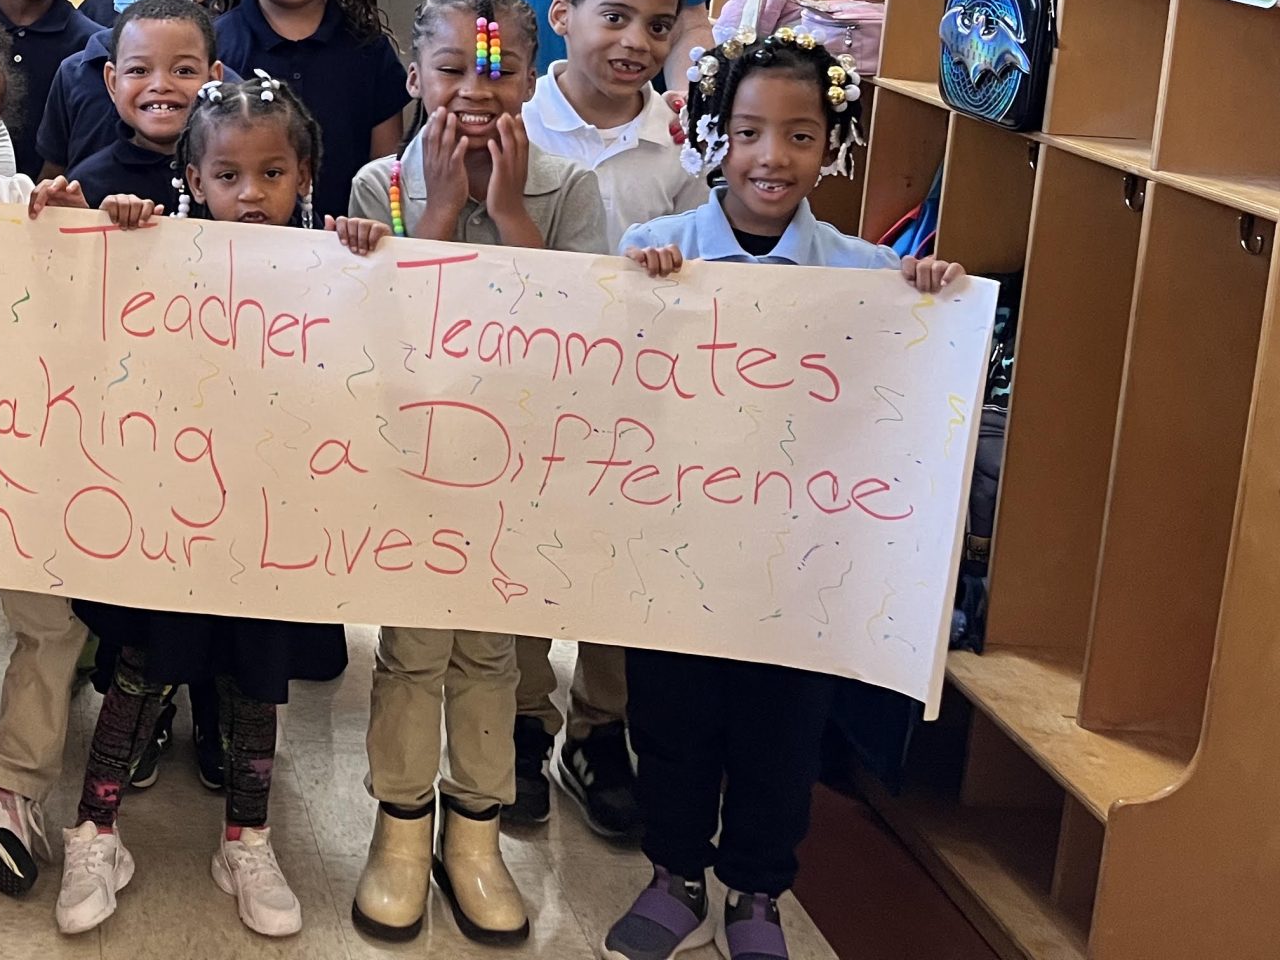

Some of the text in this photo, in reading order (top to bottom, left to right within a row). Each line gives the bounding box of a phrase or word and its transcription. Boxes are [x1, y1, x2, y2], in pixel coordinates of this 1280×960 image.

[59, 222, 331, 368] Teacher
[396, 252, 842, 403] Teammates
[308, 438, 369, 477] a
[398, 400, 915, 521] Difference
[63, 485, 215, 561] Our
